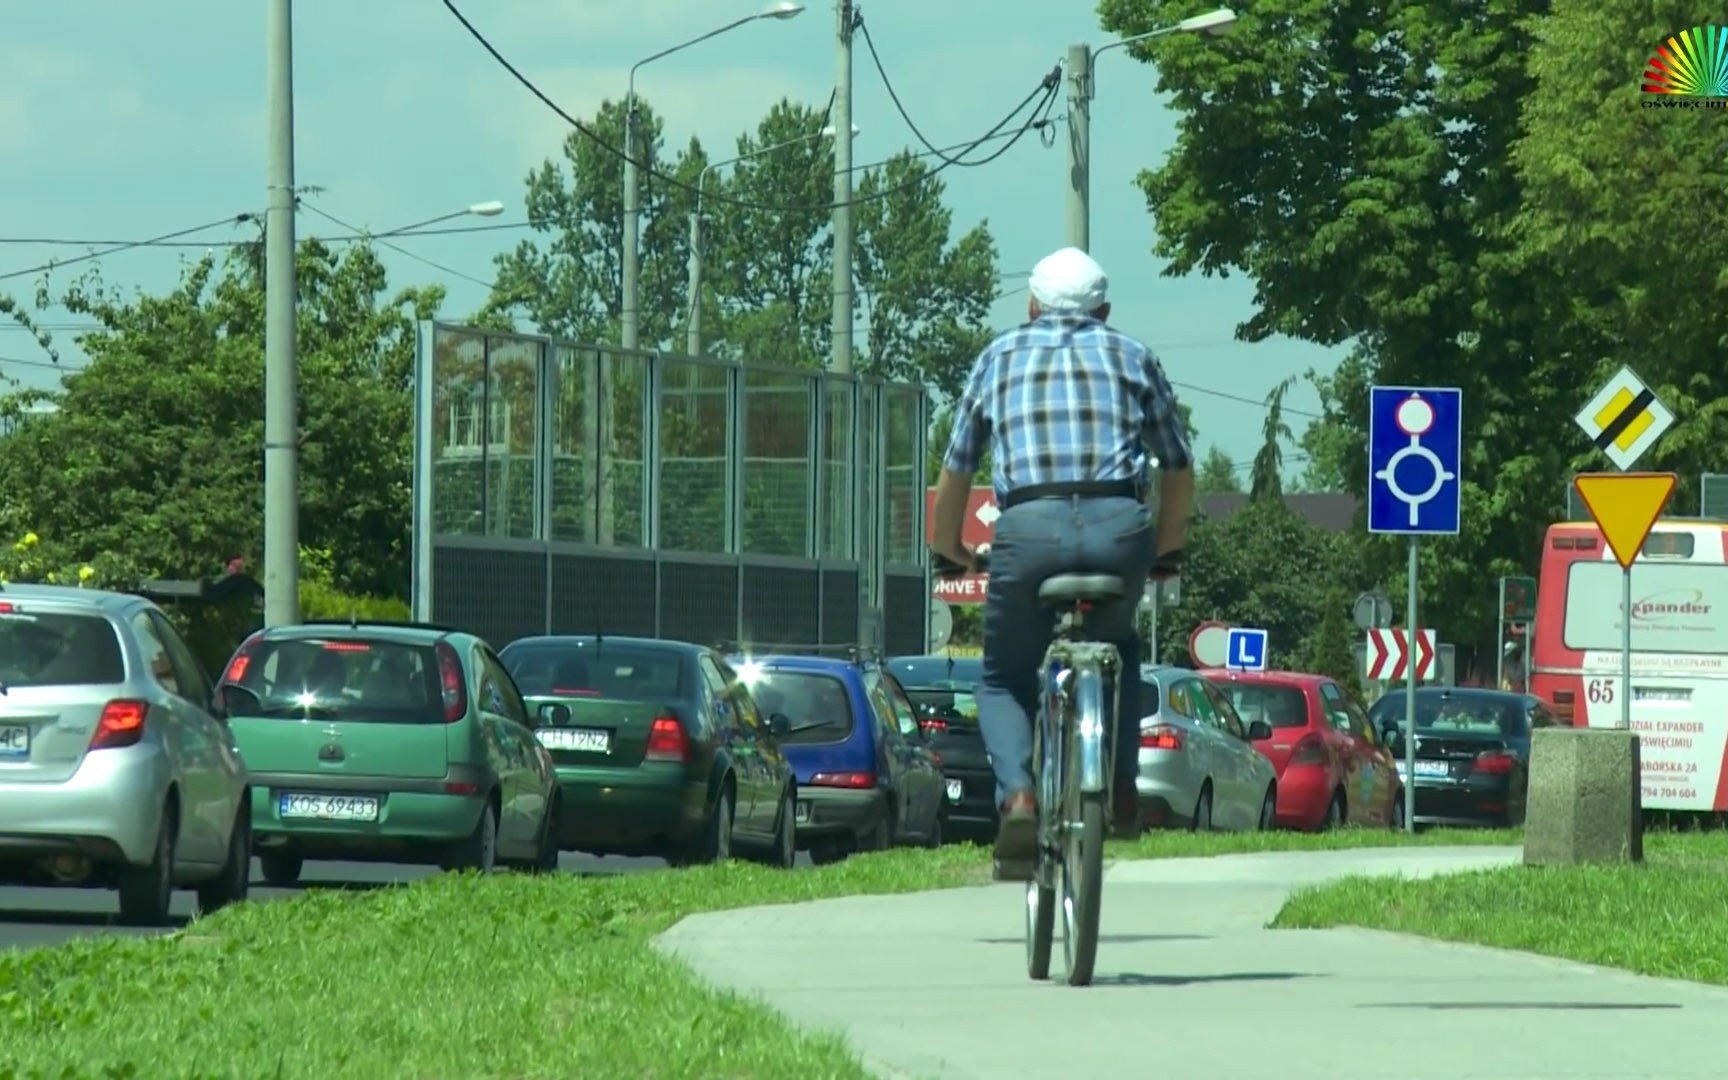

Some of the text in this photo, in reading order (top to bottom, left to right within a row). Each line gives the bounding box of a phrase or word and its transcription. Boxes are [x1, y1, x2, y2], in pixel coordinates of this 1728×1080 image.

[1619, 602, 1711, 614] xpander
[1239, 635, 1255, 663] L
[1588, 679, 1614, 704] 65
[1615, 719, 1704, 733] ODZIAŁ EXPANDER
[1641, 760, 1682, 772] ABORSKA
[289, 795, 376, 815] KOS 69433
